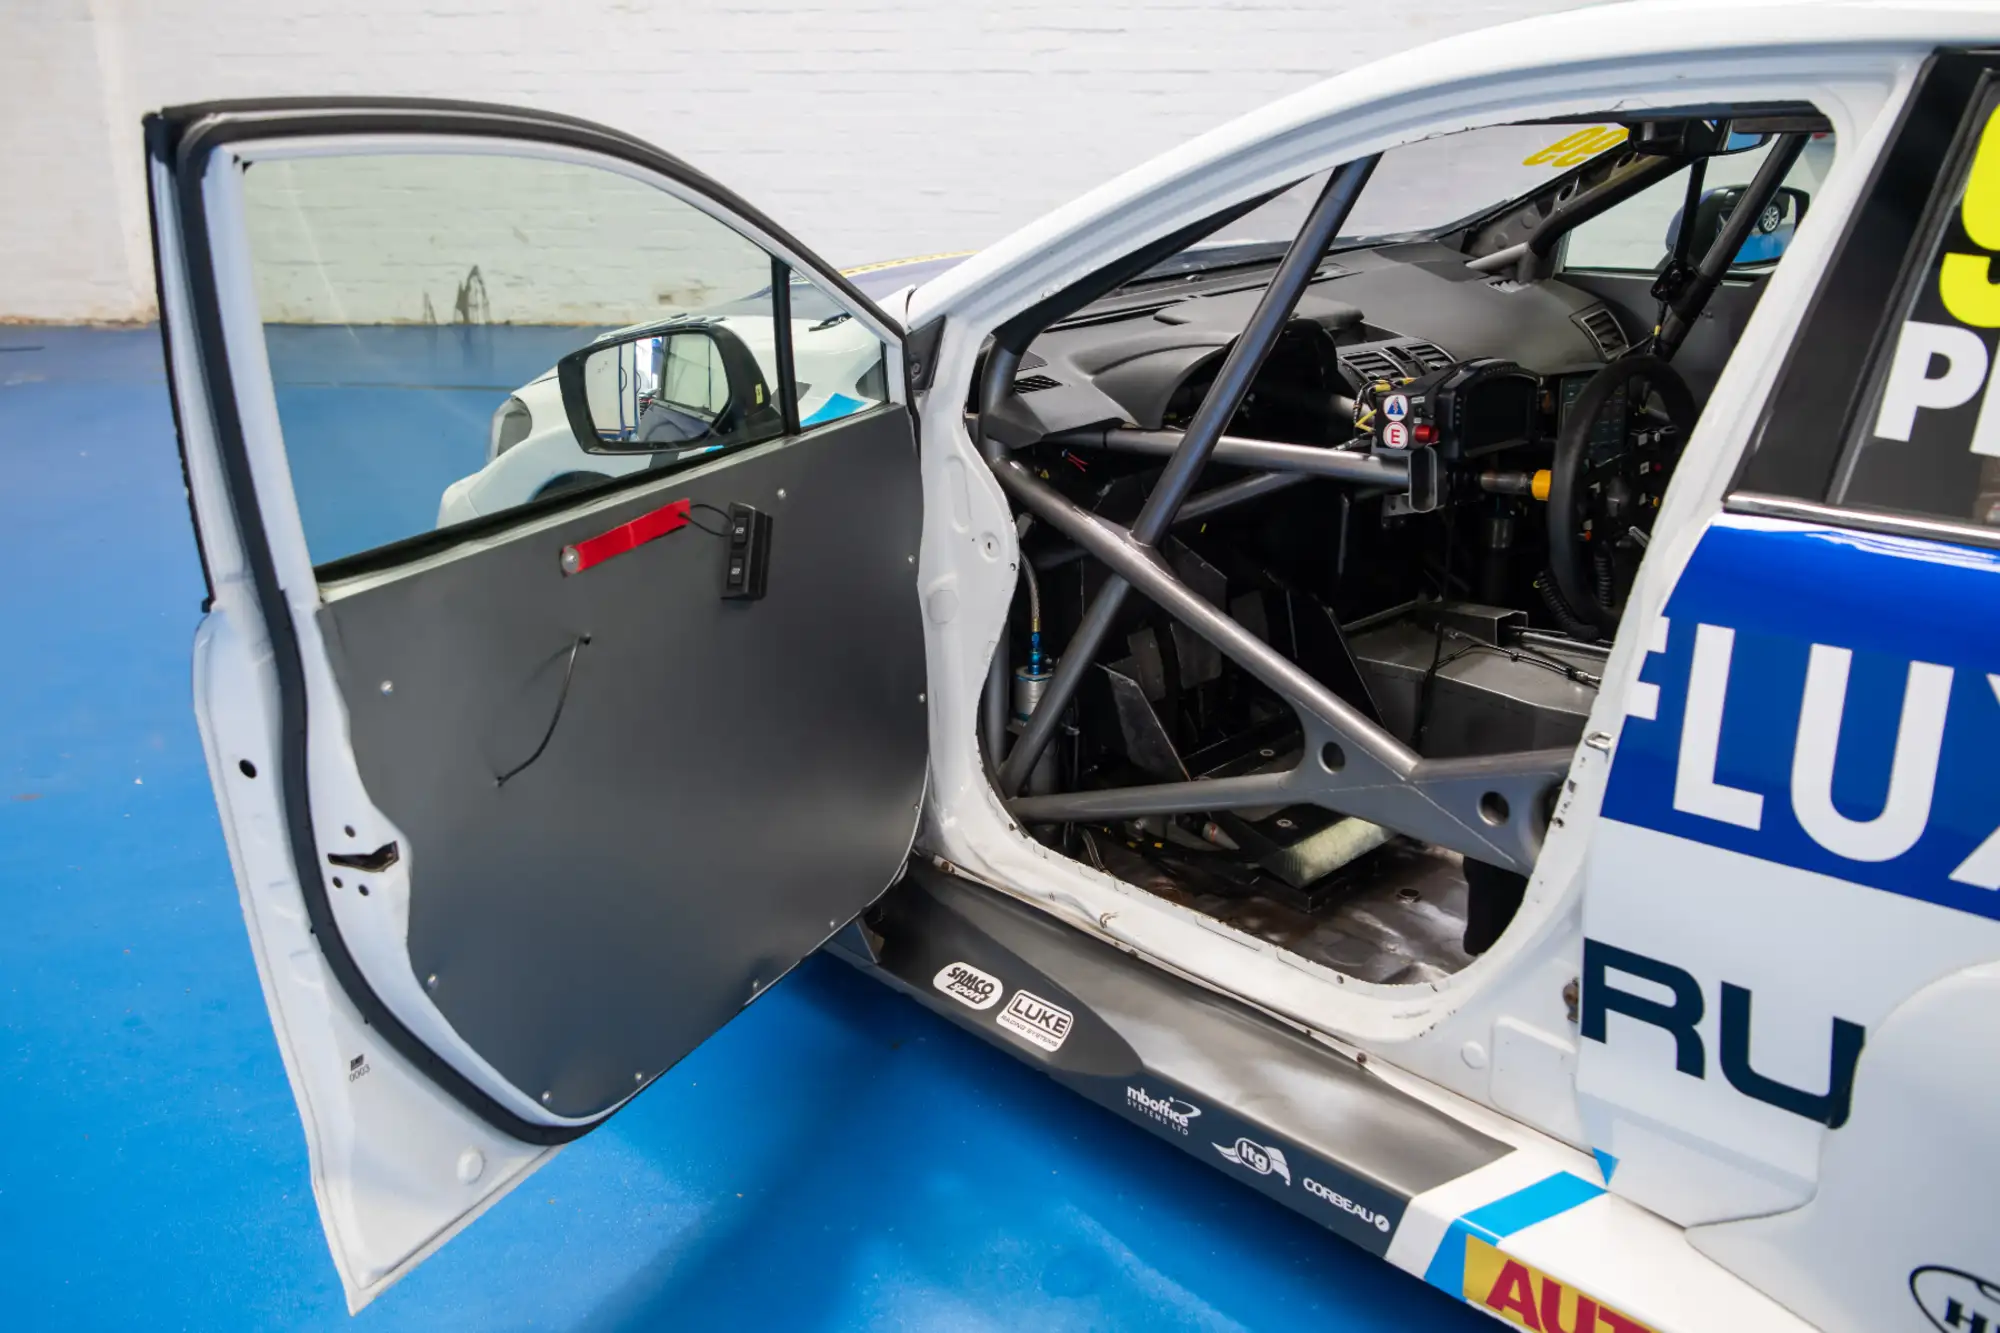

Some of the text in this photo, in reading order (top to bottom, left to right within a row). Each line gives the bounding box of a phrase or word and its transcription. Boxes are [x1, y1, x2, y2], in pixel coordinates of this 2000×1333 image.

[1873, 319, 2000, 458] P
[1391, 429, 1401, 444] E
[947, 967, 995, 995] SAMCO
[1001, 1014, 1059, 1048] RACING SYSTEMS
[1013, 998, 1068, 1035] LUKE
[1580, 937, 1866, 1130] RU
[1127, 1098, 1189, 1136] SYSTEMS LTD
[1303, 1177, 1374, 1223] CORBEAU
